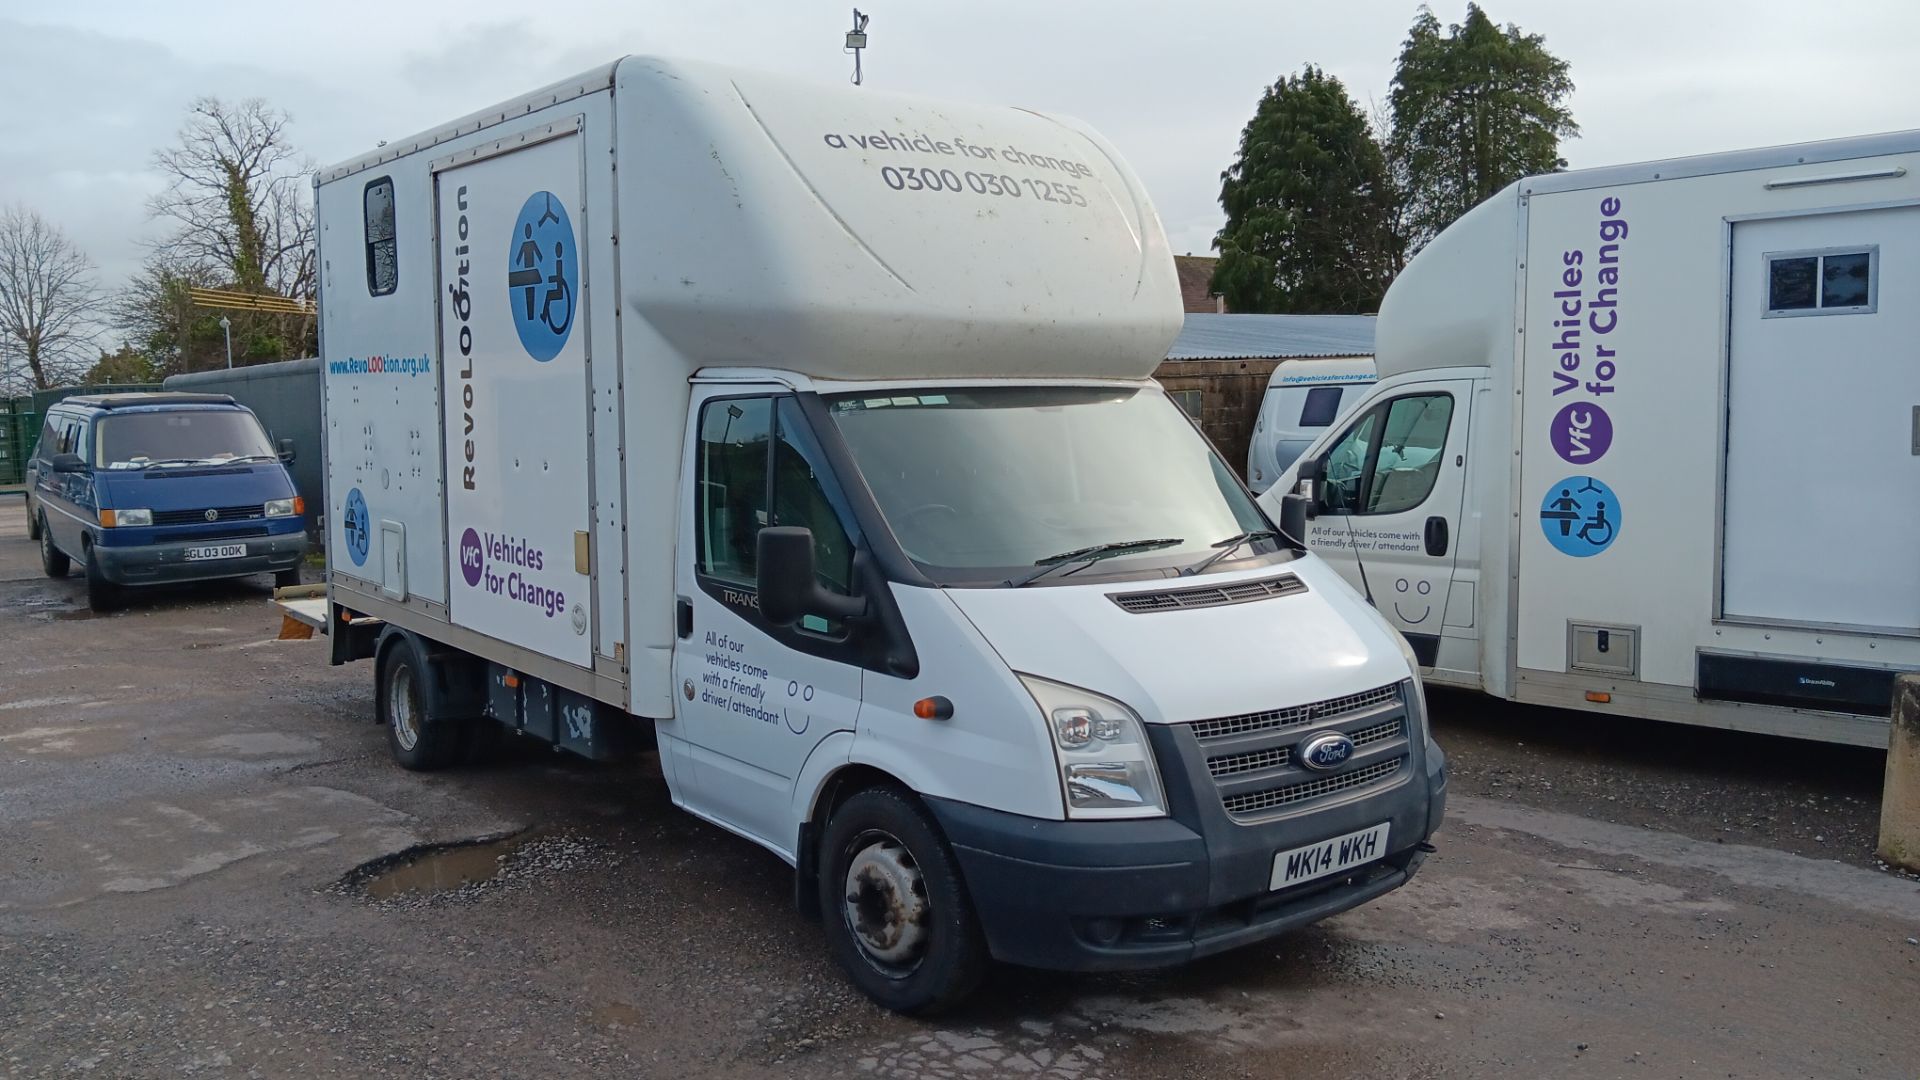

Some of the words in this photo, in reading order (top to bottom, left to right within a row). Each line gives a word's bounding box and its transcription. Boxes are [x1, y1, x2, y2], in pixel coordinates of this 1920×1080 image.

[824, 133, 846, 149] a
[848, 130, 955, 155] vehicle
[953, 137, 997, 161] for
[1001, 146, 1093, 180] change
[881, 166, 963, 193] 0300
[964, 171, 1022, 198] 030
[1022, 178, 1088, 207] 1255
[1588, 196, 1629, 335] Change
[1552, 249, 1584, 397] Vehicles
[329, 353, 430, 377] www.RevoLOOtion.org.uk
[1282, 374, 1378, 383] info@vehiclesforchange.or
[1585, 344, 1616, 397] for
[1568, 409, 1593, 457] VfC
[1311, 527, 1321, 535] All
[1322, 527, 1331, 536] of
[1346, 528, 1377, 538] vehicles
[1378, 532, 1401, 540] come
[1402, 531, 1421, 541] with
[1317, 538, 1346, 549] friendly
[1347, 539, 1370, 549] driver
[1378, 542, 1420, 552] attendant
[189, 548, 219, 559] GL03
[221, 546, 242, 557] ODK
[462, 545, 480, 568] VfC
[484, 532, 543, 571] Vehicles
[484, 564, 505, 595] for
[508, 572, 565, 618] Change
[724, 590, 760, 609] TRANS
[705, 631, 717, 646] All
[718, 634, 728, 649] of
[728, 640, 744, 654] our
[706, 652, 741, 672] vehicles
[742, 662, 768, 680] come
[702, 670, 721, 685] with
[722, 679, 729, 689] a
[729, 677, 766, 704] friendly
[1319, 742, 1346, 762] Ford
[1285, 844, 1333, 881] MK14
[1338, 831, 1378, 866] WKH
